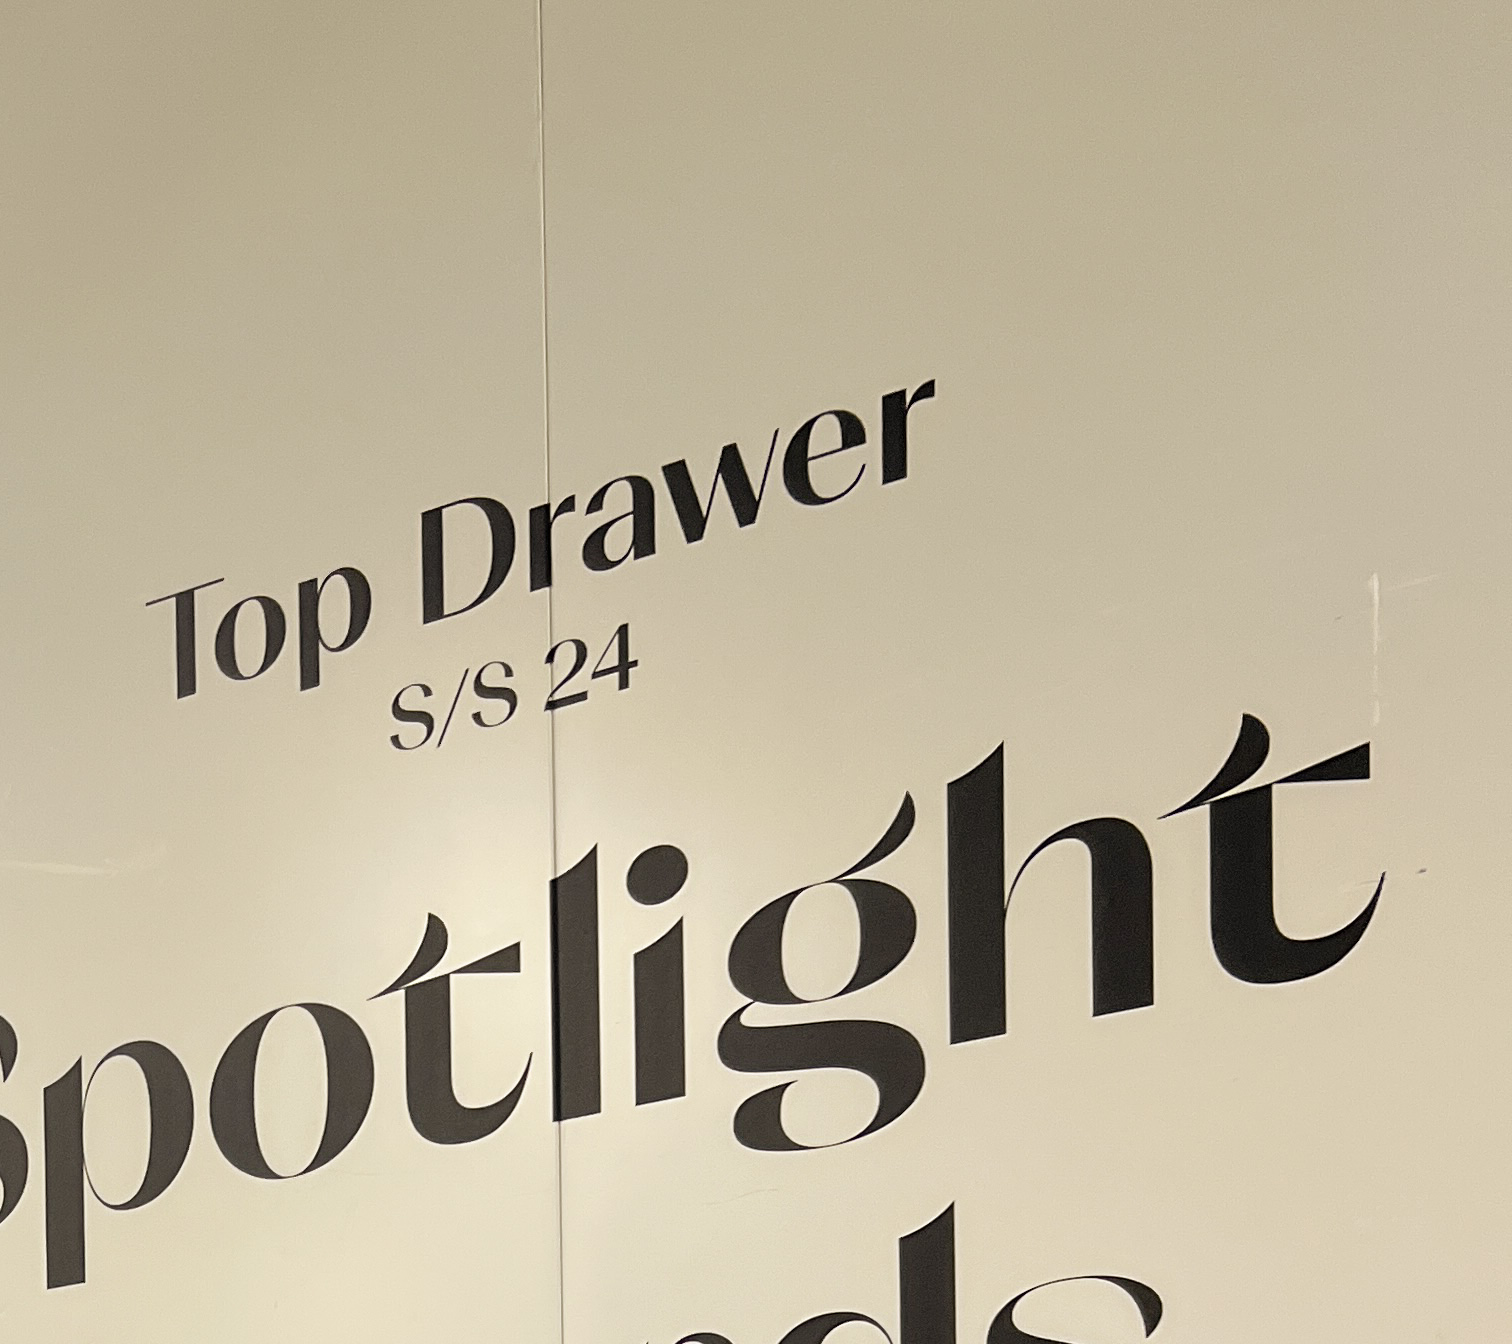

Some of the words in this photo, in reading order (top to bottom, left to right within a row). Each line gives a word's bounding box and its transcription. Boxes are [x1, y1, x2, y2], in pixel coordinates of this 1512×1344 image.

[145, 561, 373, 699] Top
[421, 378, 936, 625] Drawer
[388, 658, 519, 751] S/S
[542, 620, 641, 711] 24
